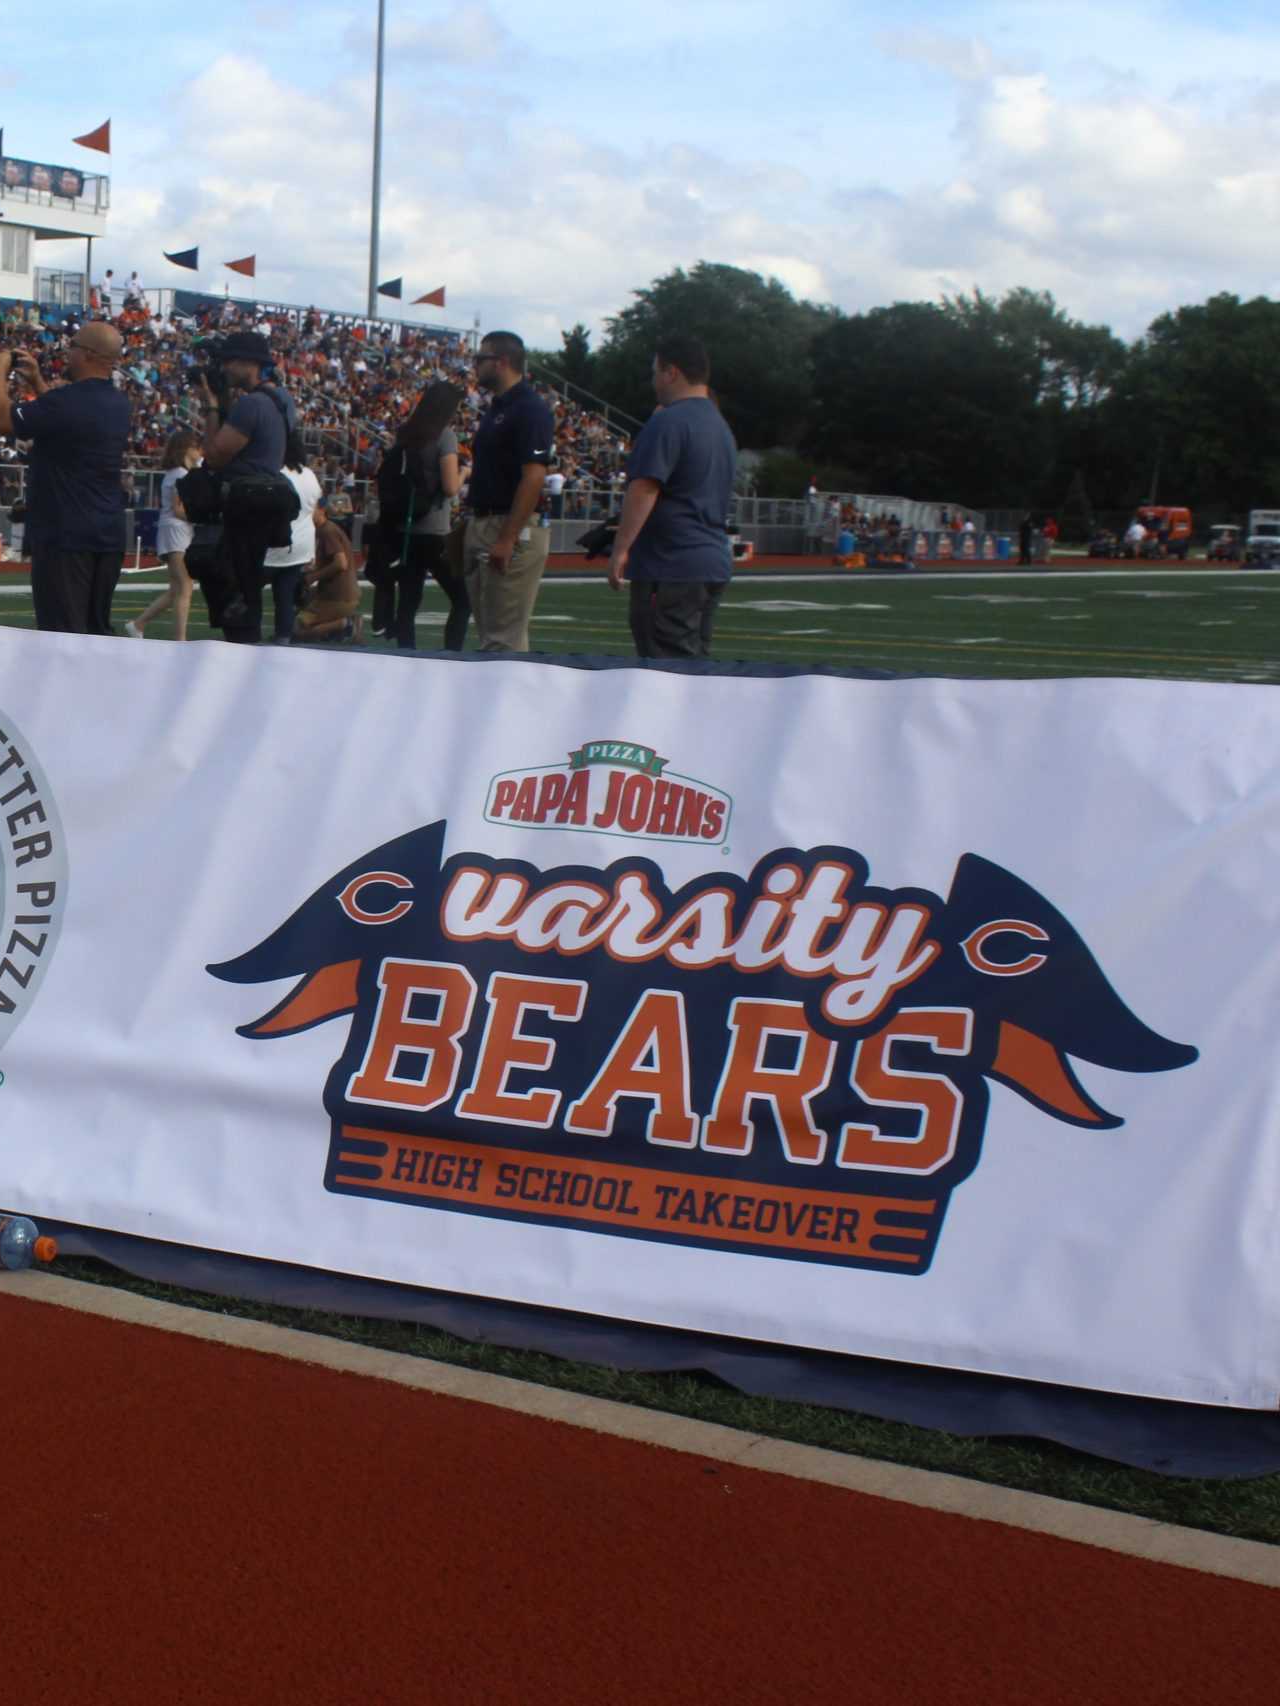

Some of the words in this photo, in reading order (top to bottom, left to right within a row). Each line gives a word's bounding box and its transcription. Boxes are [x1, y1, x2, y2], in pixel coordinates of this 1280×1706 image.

[588, 744, 647, 765] PIZZA
[490, 769, 591, 826] PAPA
[593, 770, 726, 840] JOHN'S
[442, 862, 939, 1022] varsity
[345, 957, 974, 1176] BEARS
[392, 1148, 483, 1192] HIGH
[495, 1162, 640, 1216] SCHOOL
[655, 1185, 862, 1245] TAKEOVER
